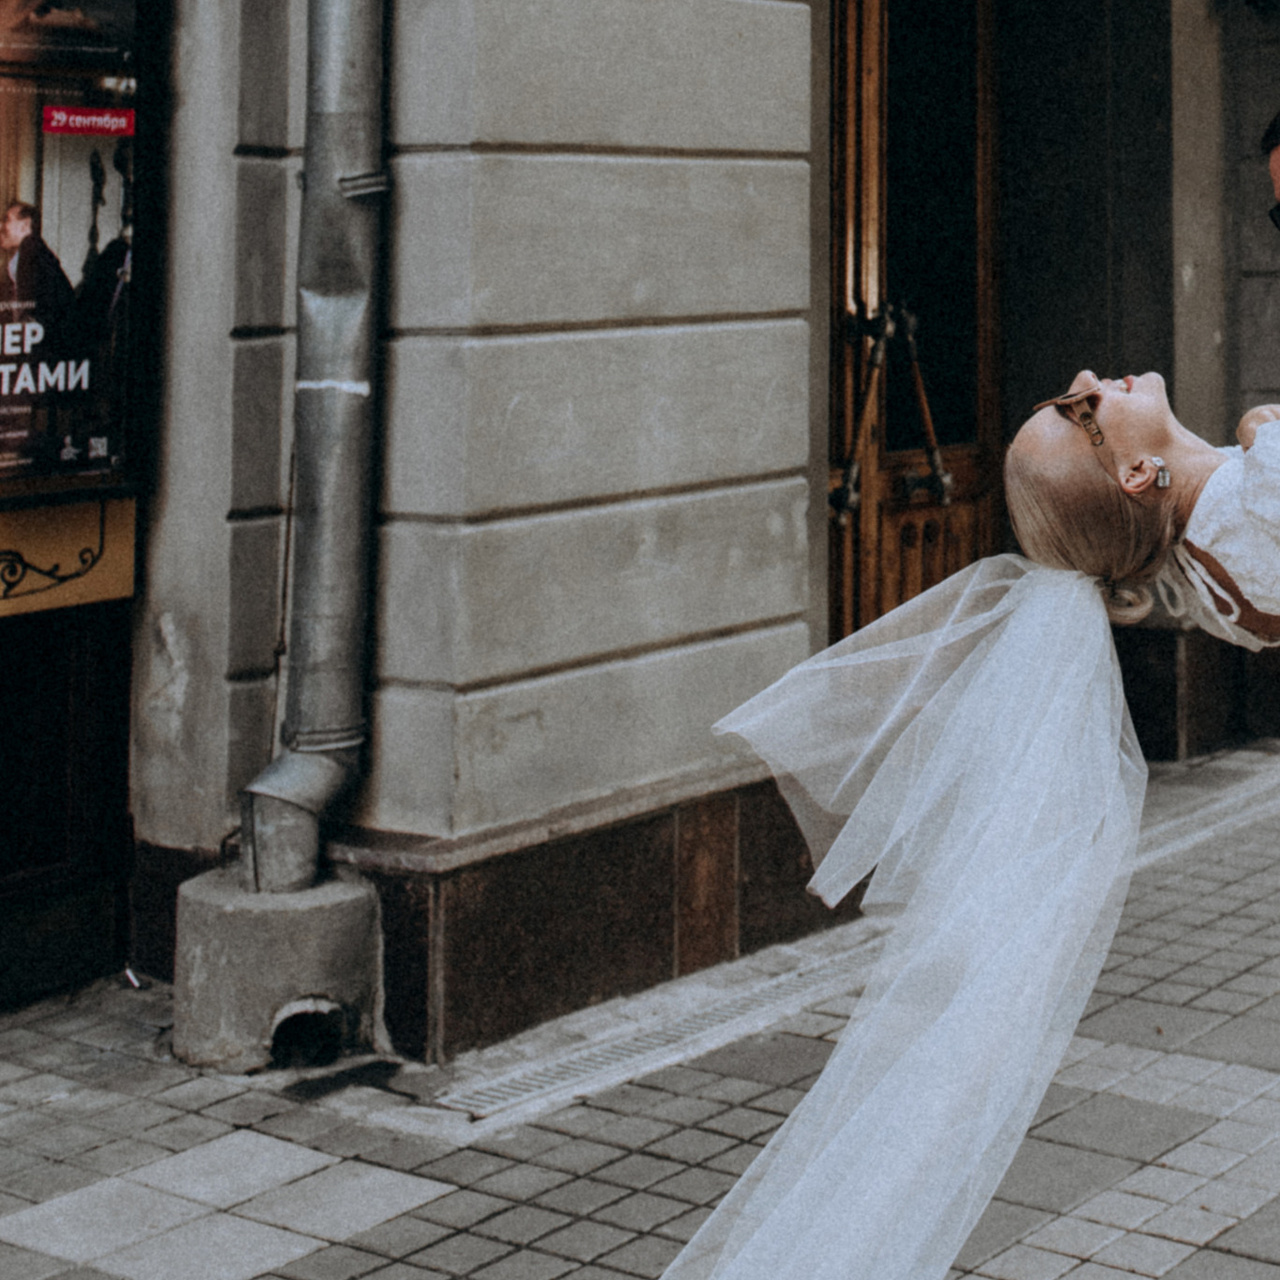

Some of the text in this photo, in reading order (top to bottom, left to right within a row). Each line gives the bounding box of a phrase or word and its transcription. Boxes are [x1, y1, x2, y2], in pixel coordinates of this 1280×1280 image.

[51, 110, 127, 131] 29 сентября
[0, 321, 44, 355] ЕР
[0, 358, 90, 396] ТАМИ
